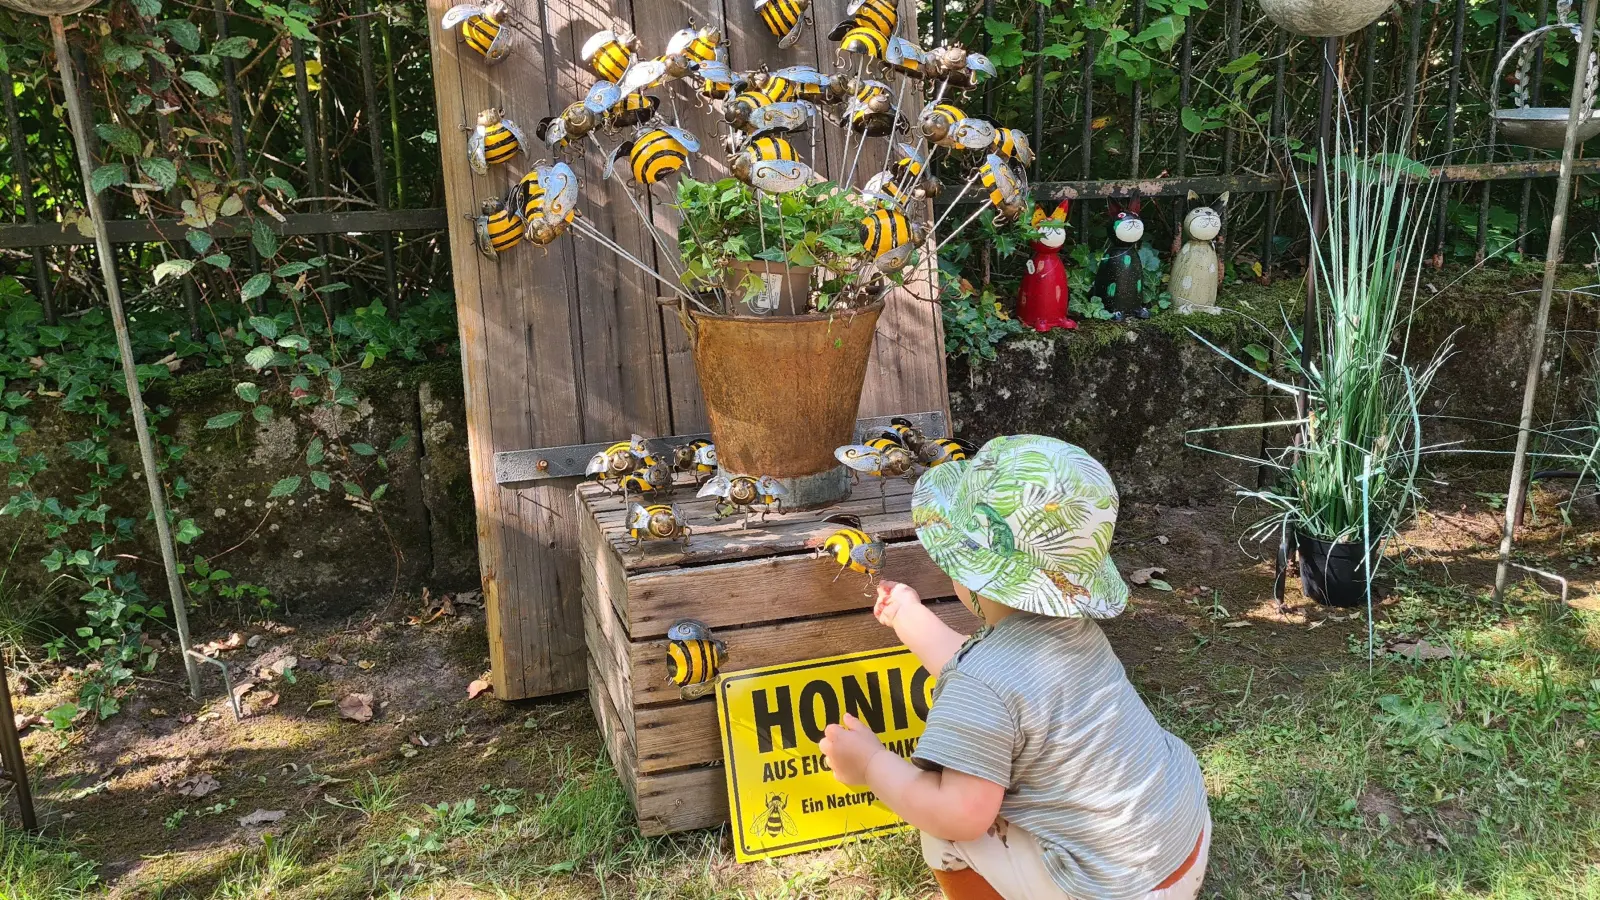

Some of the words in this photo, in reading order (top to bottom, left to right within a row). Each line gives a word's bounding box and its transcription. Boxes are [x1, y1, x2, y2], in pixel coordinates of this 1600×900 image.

[752, 665, 934, 754] HONIG
[763, 758, 798, 783] AUS
[801, 797, 824, 814] Ein
[826, 790, 879, 809] Naturp
